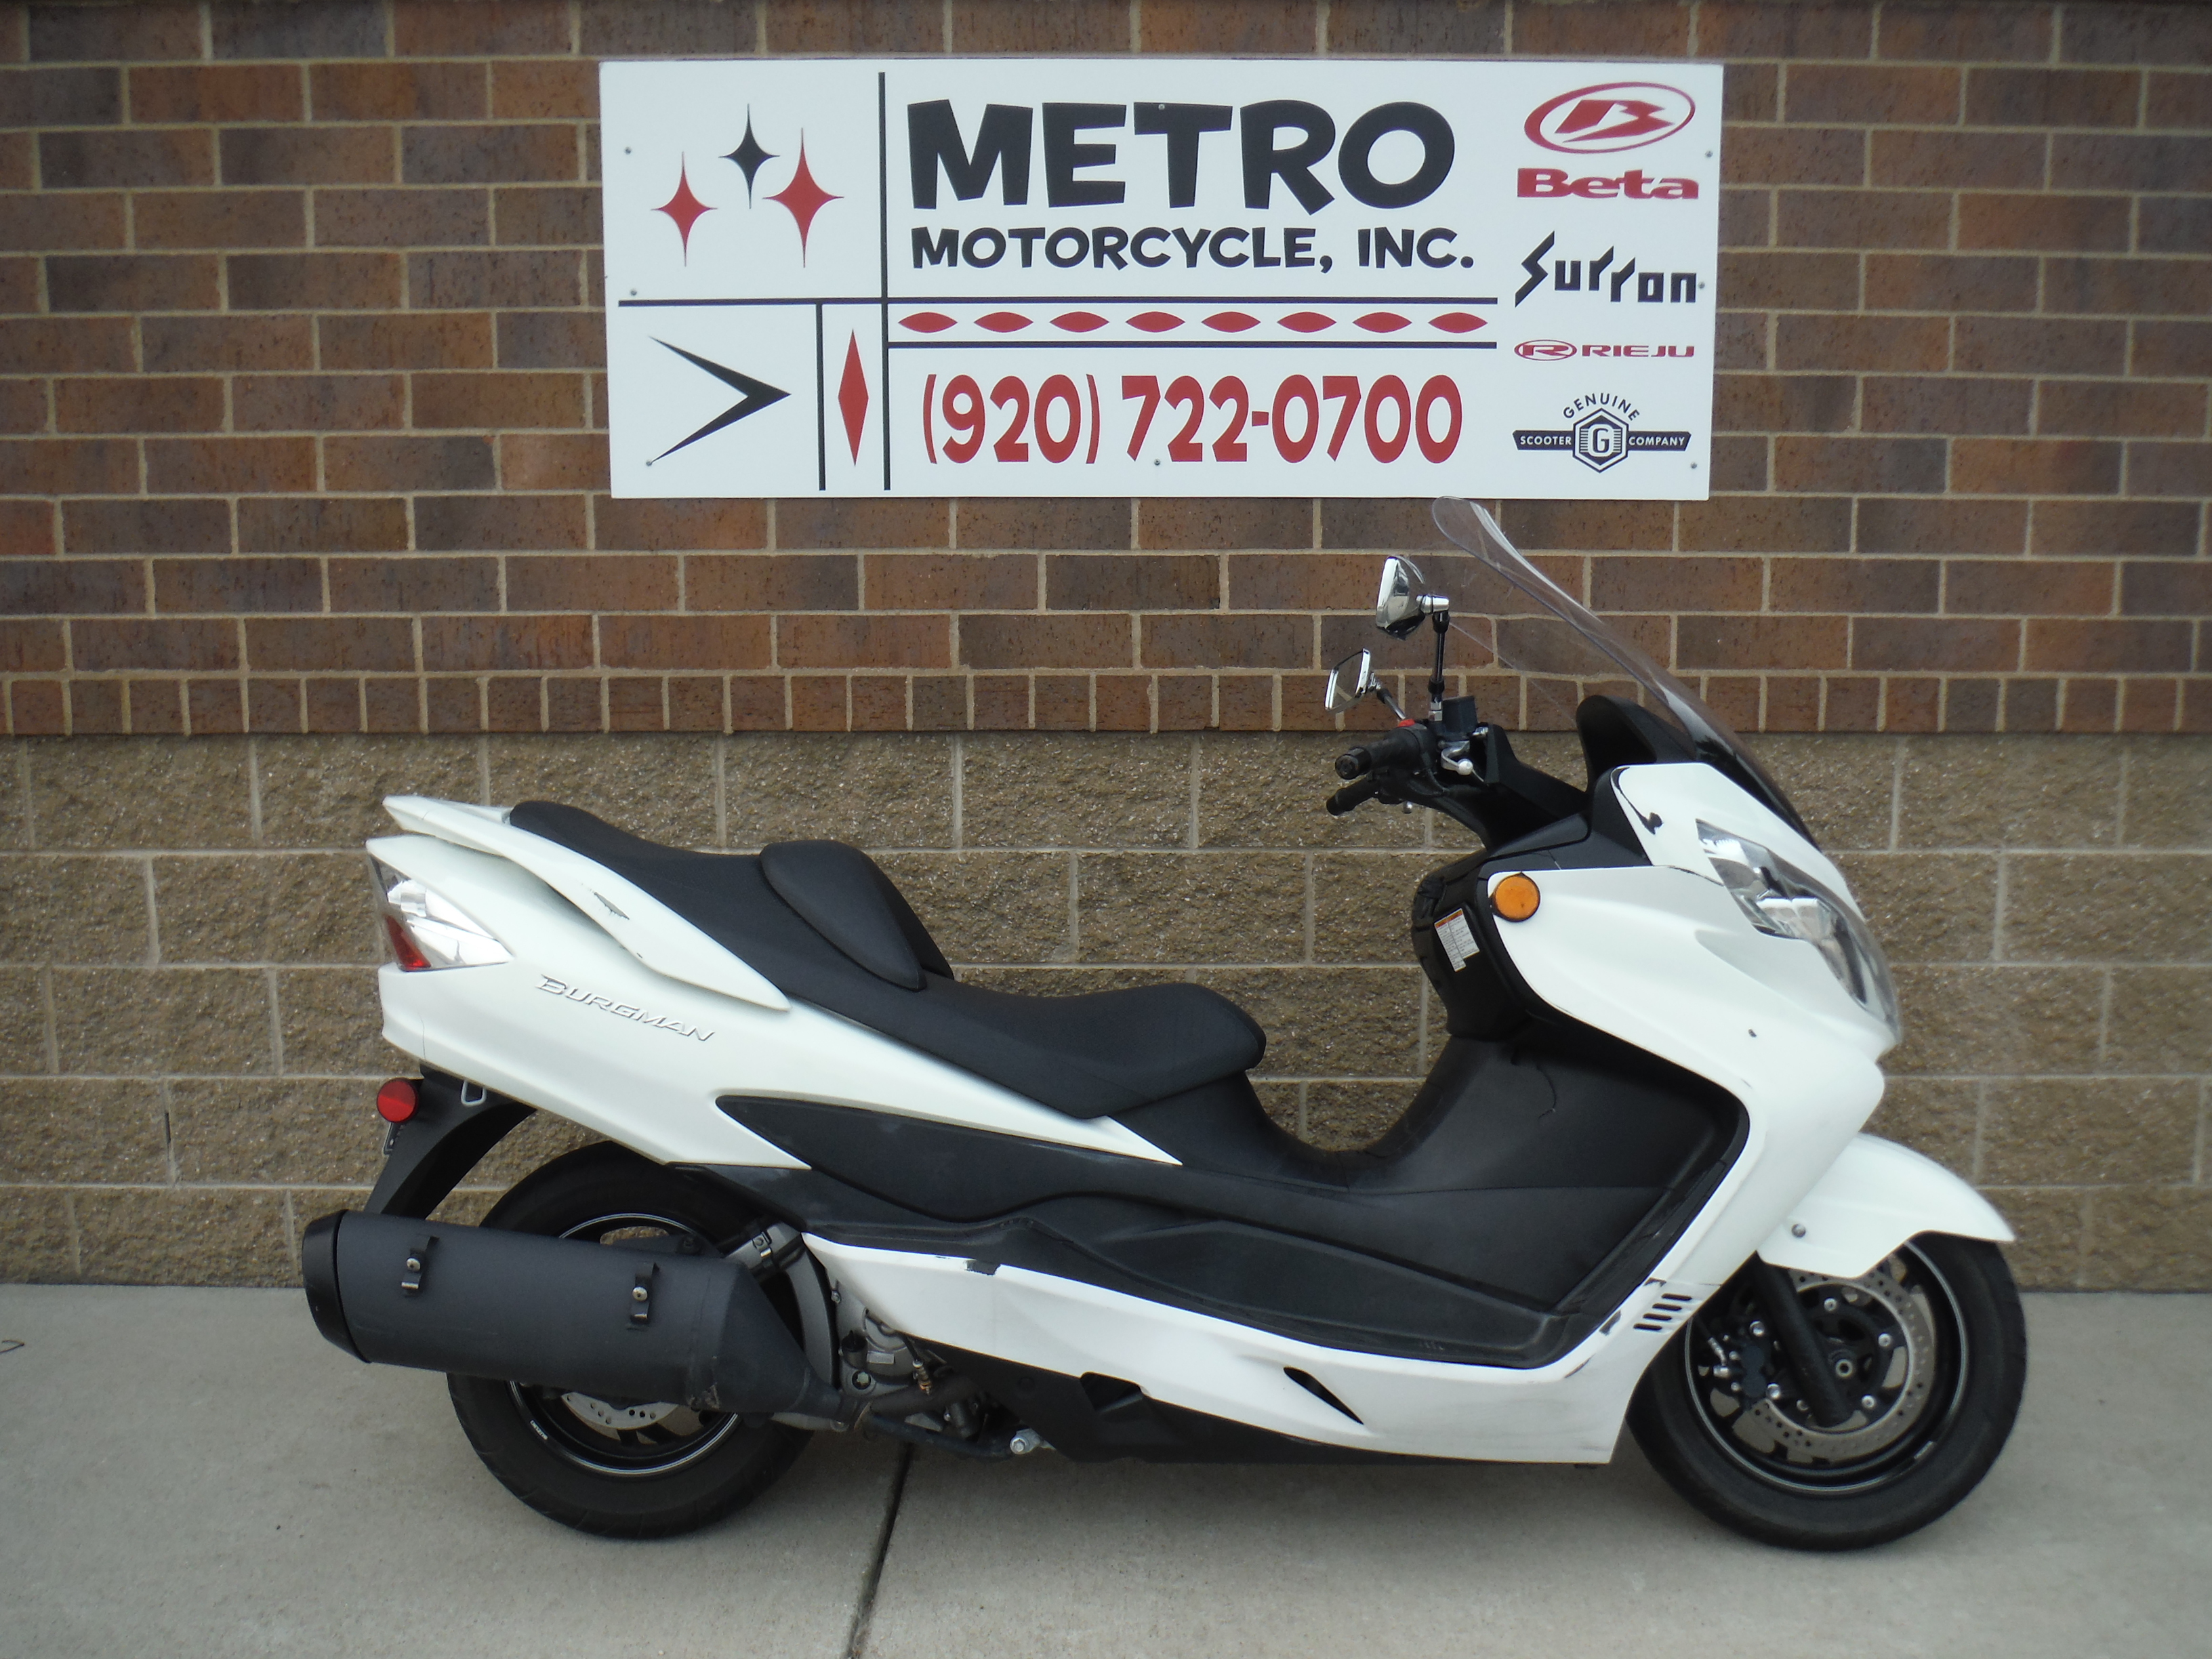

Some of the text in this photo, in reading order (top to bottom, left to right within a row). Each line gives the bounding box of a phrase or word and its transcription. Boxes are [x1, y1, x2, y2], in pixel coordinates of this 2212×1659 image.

[907, 99, 1455, 216] METRO
[1517, 167, 1699, 199] Beta
[911, 226, 1474, 274] MOTORCYCLE, INC.
[1582, 344, 1694, 357] RIEJU
[923, 373, 1462, 464] (920) 722-0700
[1563, 392, 1640, 421] GENUINE
[1520, 436, 1572, 445] SCOOTER
[1629, 436, 1685, 446] COMPANY
[535, 973, 715, 1042] BURGMAN
